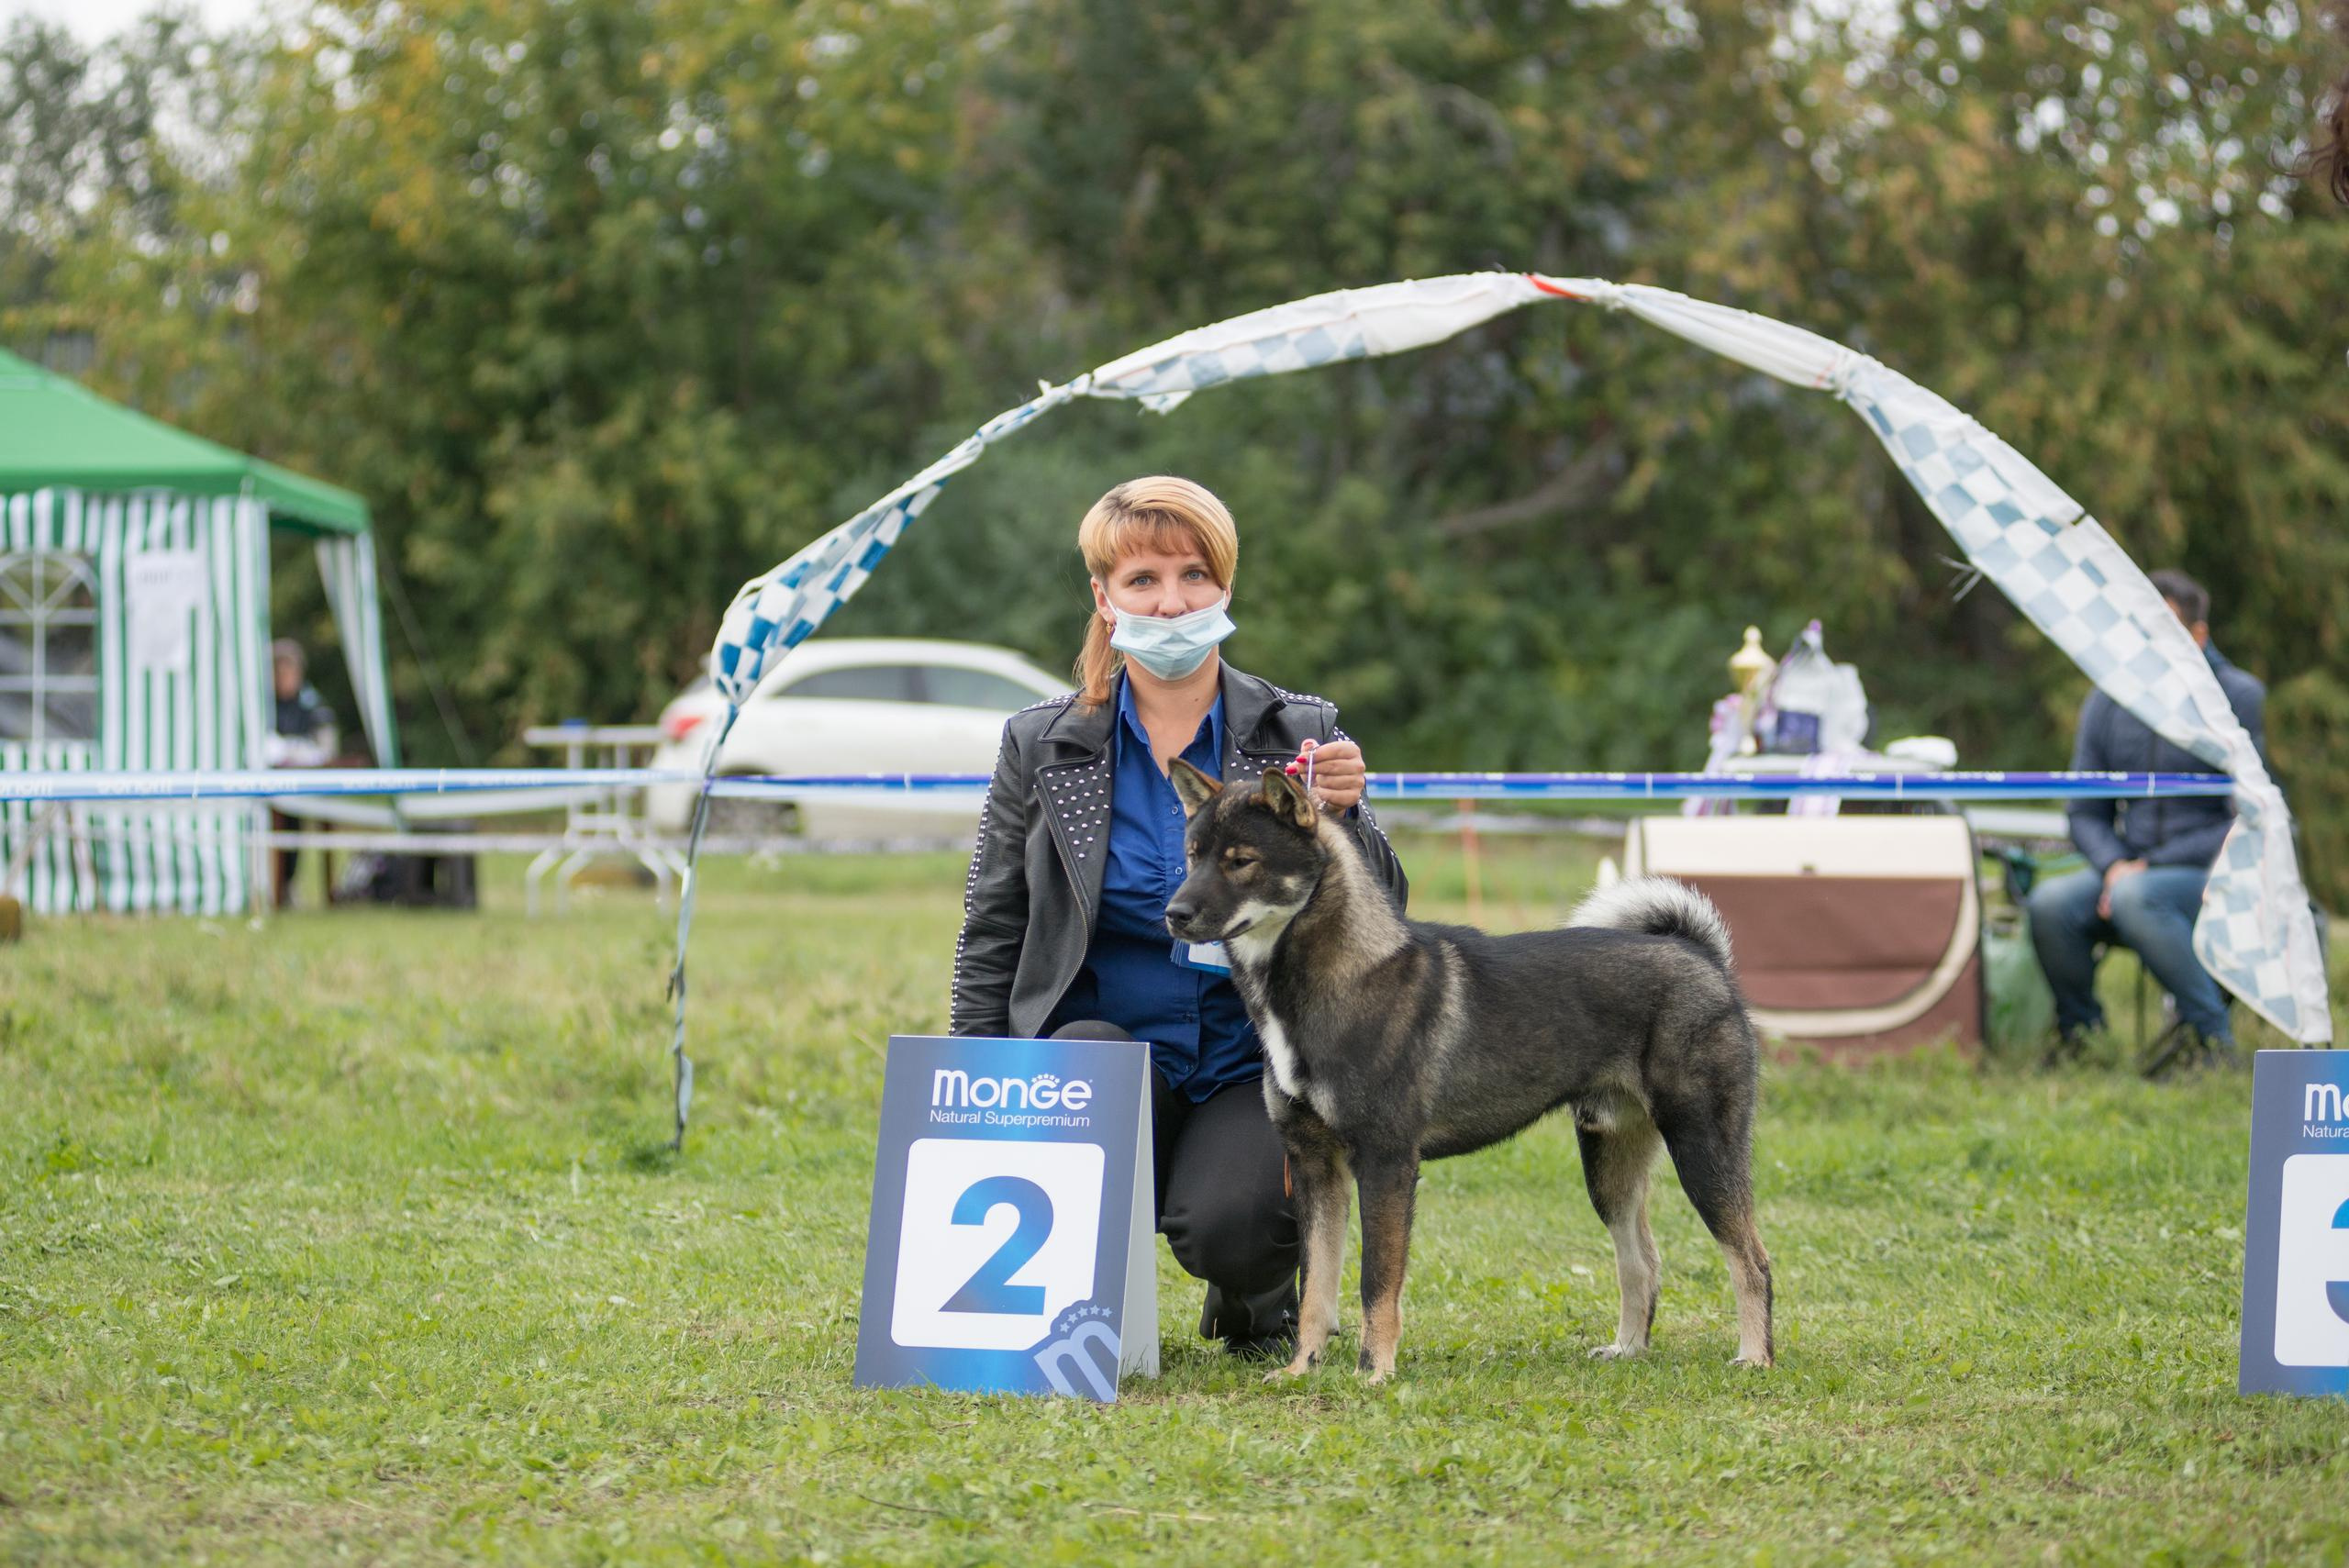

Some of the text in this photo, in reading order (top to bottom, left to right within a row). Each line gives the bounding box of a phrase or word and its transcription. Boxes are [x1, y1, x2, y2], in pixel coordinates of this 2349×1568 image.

[930, 1109, 1090, 1129] Natural Superpremium
[2304, 1084, 2349, 1121] m
[938, 1175, 1054, 1316] 2
